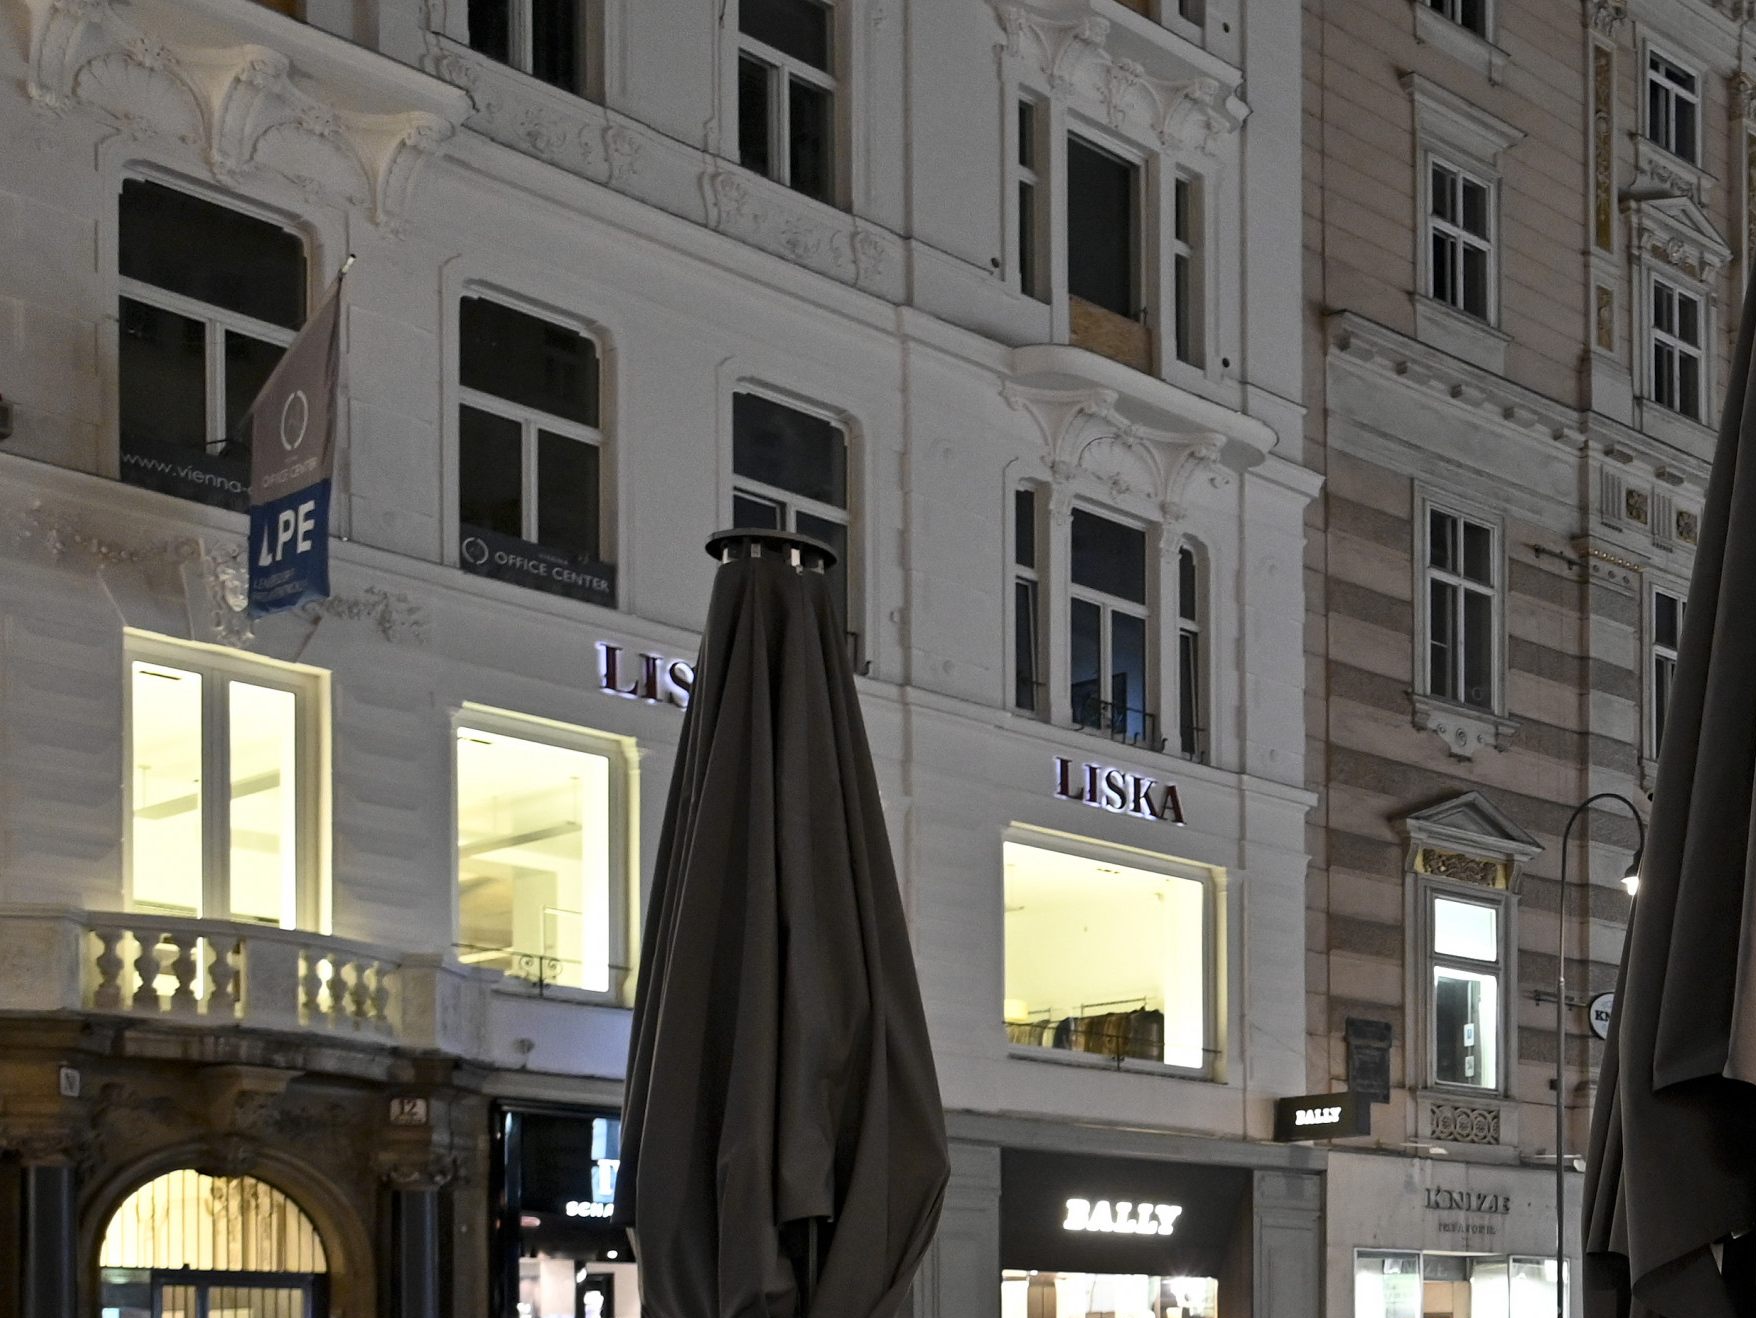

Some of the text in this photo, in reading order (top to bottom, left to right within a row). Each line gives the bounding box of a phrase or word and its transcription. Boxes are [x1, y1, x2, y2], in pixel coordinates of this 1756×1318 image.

[494, 551, 548, 577] OFFICE
[552, 566, 610, 594] CENTER
[1055, 757, 1187, 826] LISKA
[1595, 1010, 1610, 1022] KN
[1295, 1106, 1342, 1126] BALLY
[1063, 1198, 1183, 1236] BALLY
[1425, 1186, 1511, 1215] KNIZE
